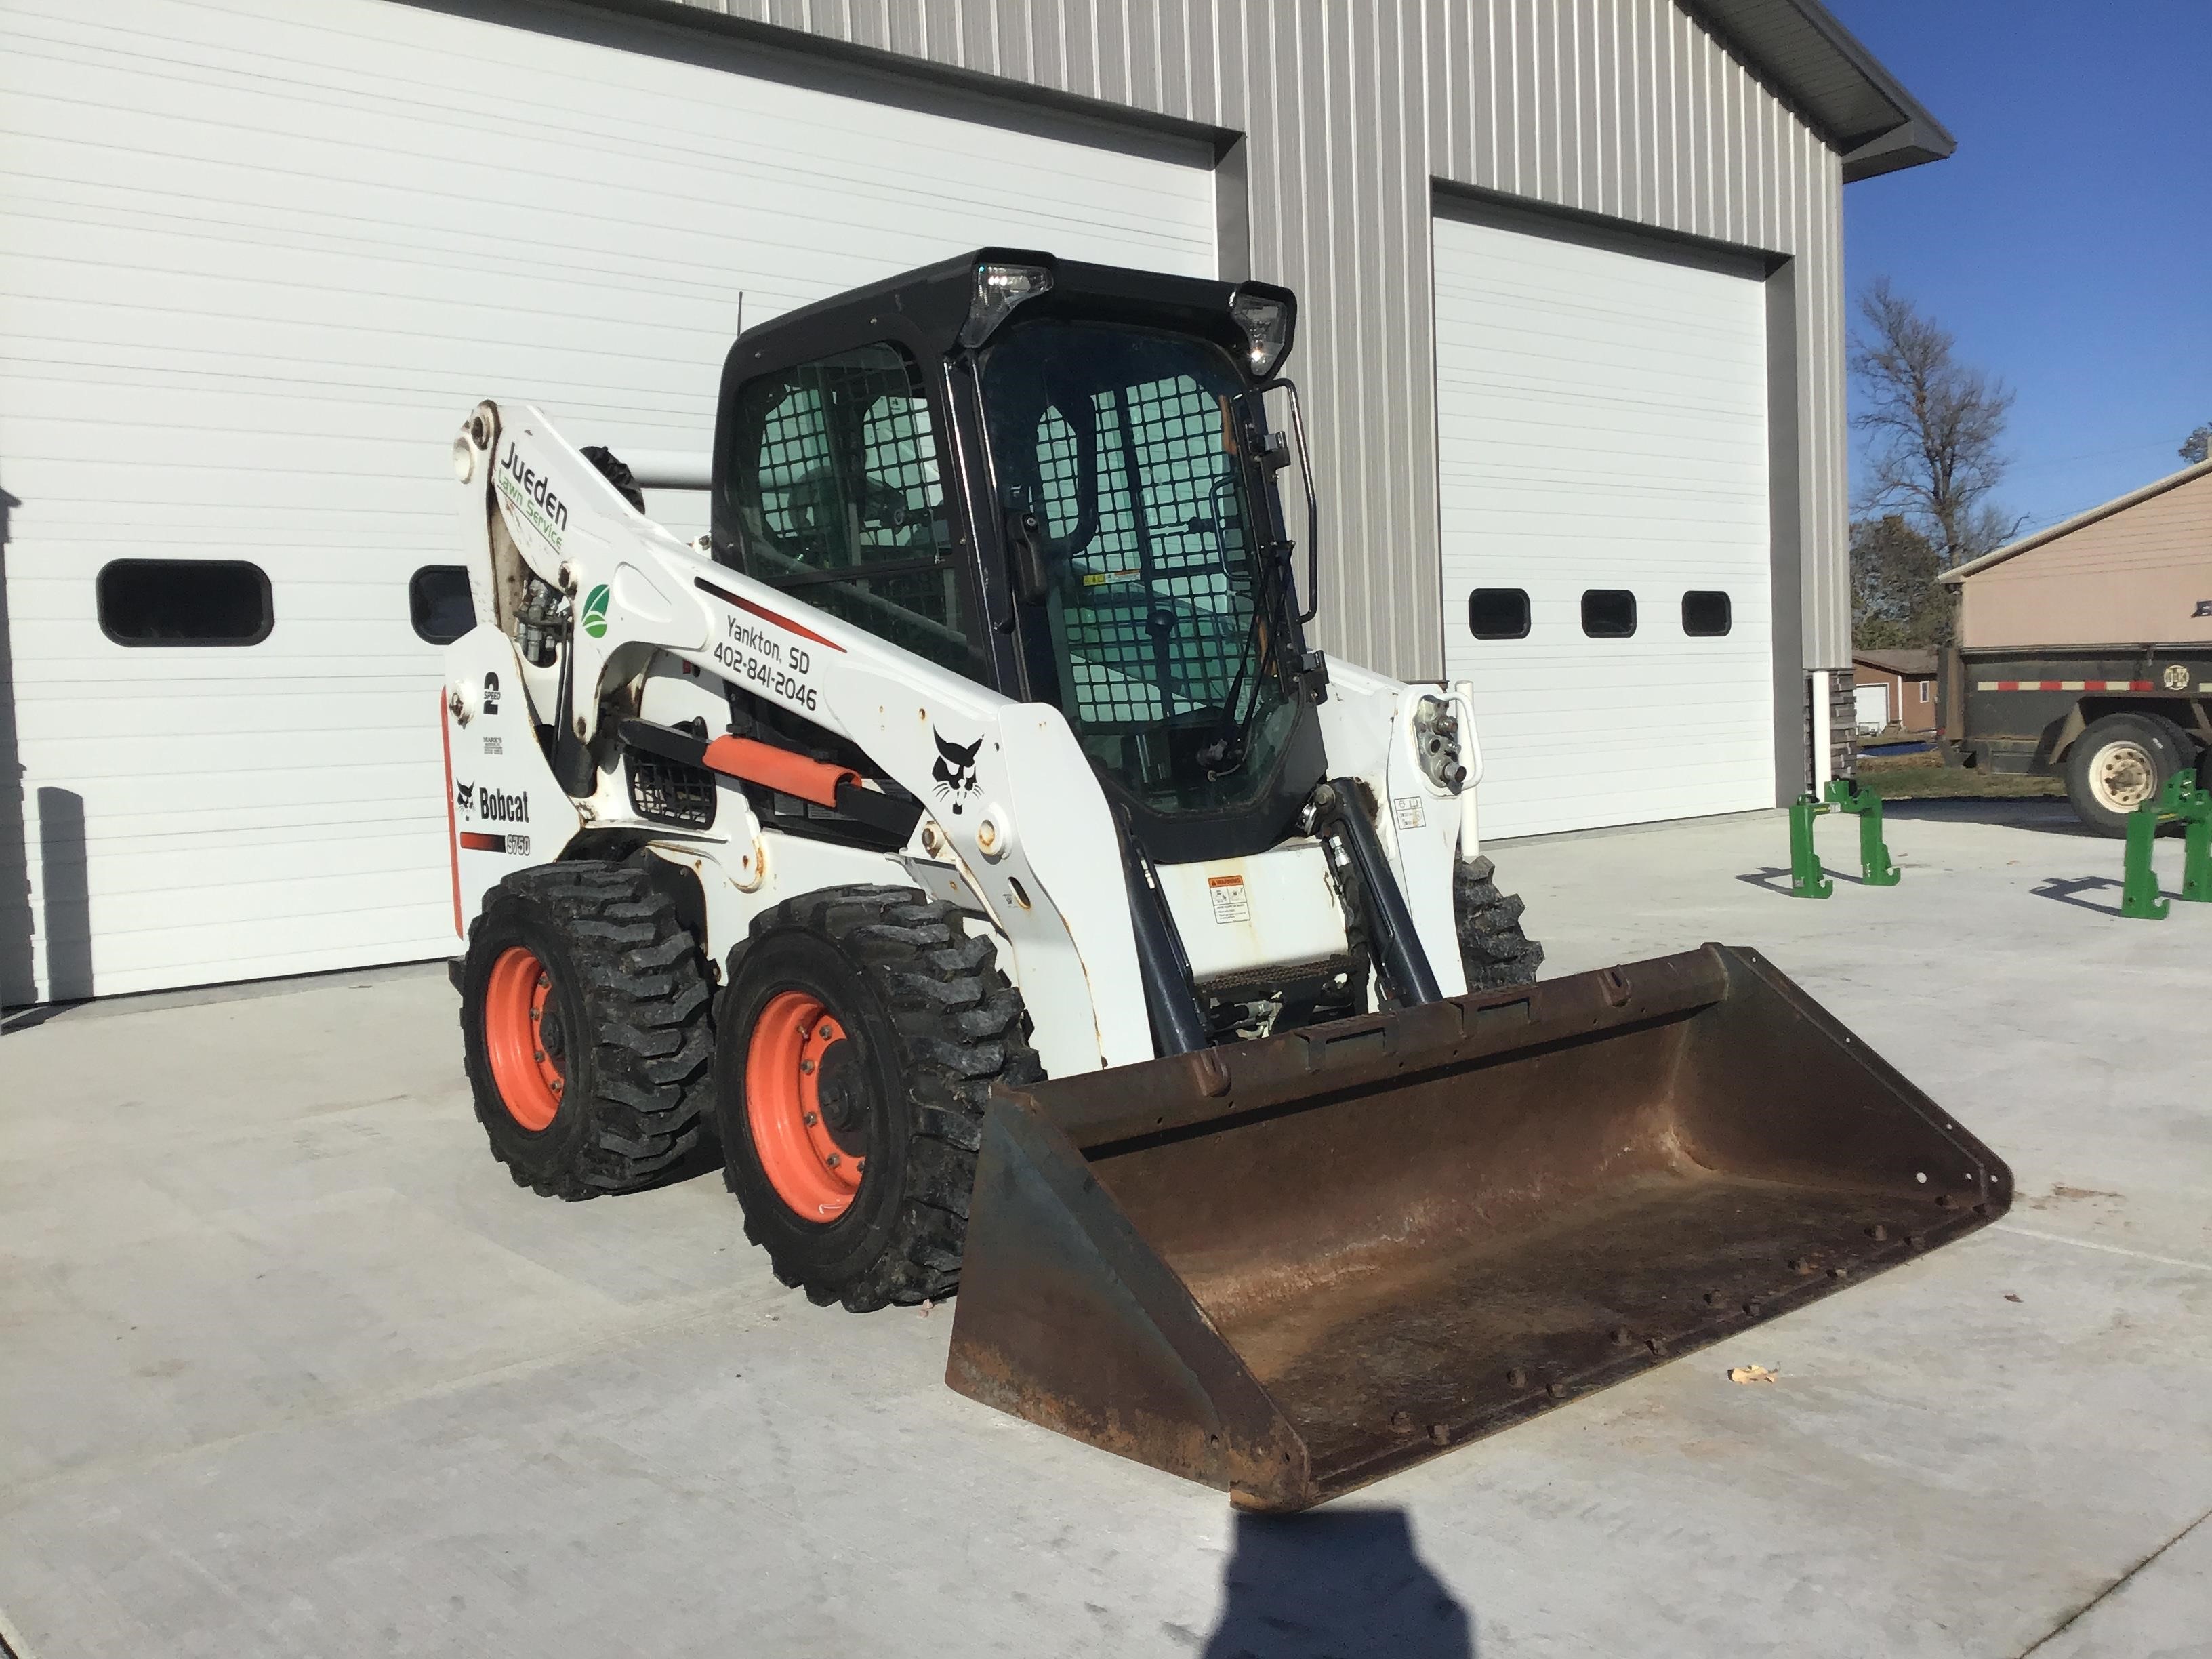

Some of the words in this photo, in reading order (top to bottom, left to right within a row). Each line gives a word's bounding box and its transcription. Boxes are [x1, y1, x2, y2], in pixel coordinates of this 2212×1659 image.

[501, 442, 567, 531] Jueden
[498, 468, 523, 506] Lawn
[525, 499, 563, 550] Service
[714, 642, 817, 712] 402-841-2046
[788, 646, 810, 675] SD
[483, 671, 499, 715] 2
[483, 691, 501, 700] SPEED
[479, 787, 529, 823] Bobcat
[506, 834, 531, 856] S750
